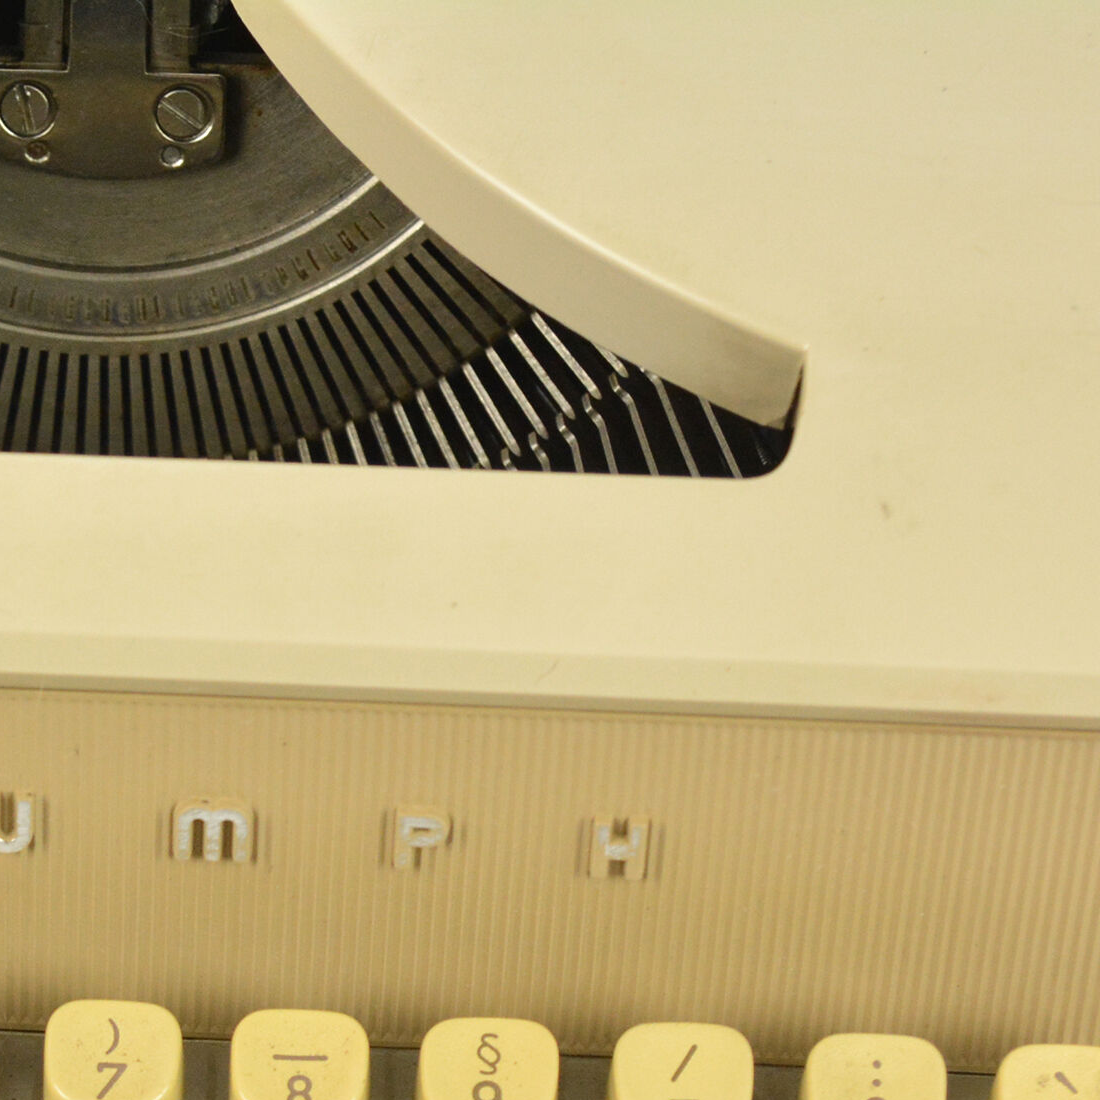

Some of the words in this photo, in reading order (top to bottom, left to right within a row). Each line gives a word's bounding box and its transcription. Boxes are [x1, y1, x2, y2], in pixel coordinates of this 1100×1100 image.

[105, 1017, 120, 1056] )
[476, 1032, 502, 1076] §
[96, 1061, 128, 1100] 7
[670, 1044, 698, 1083] /
